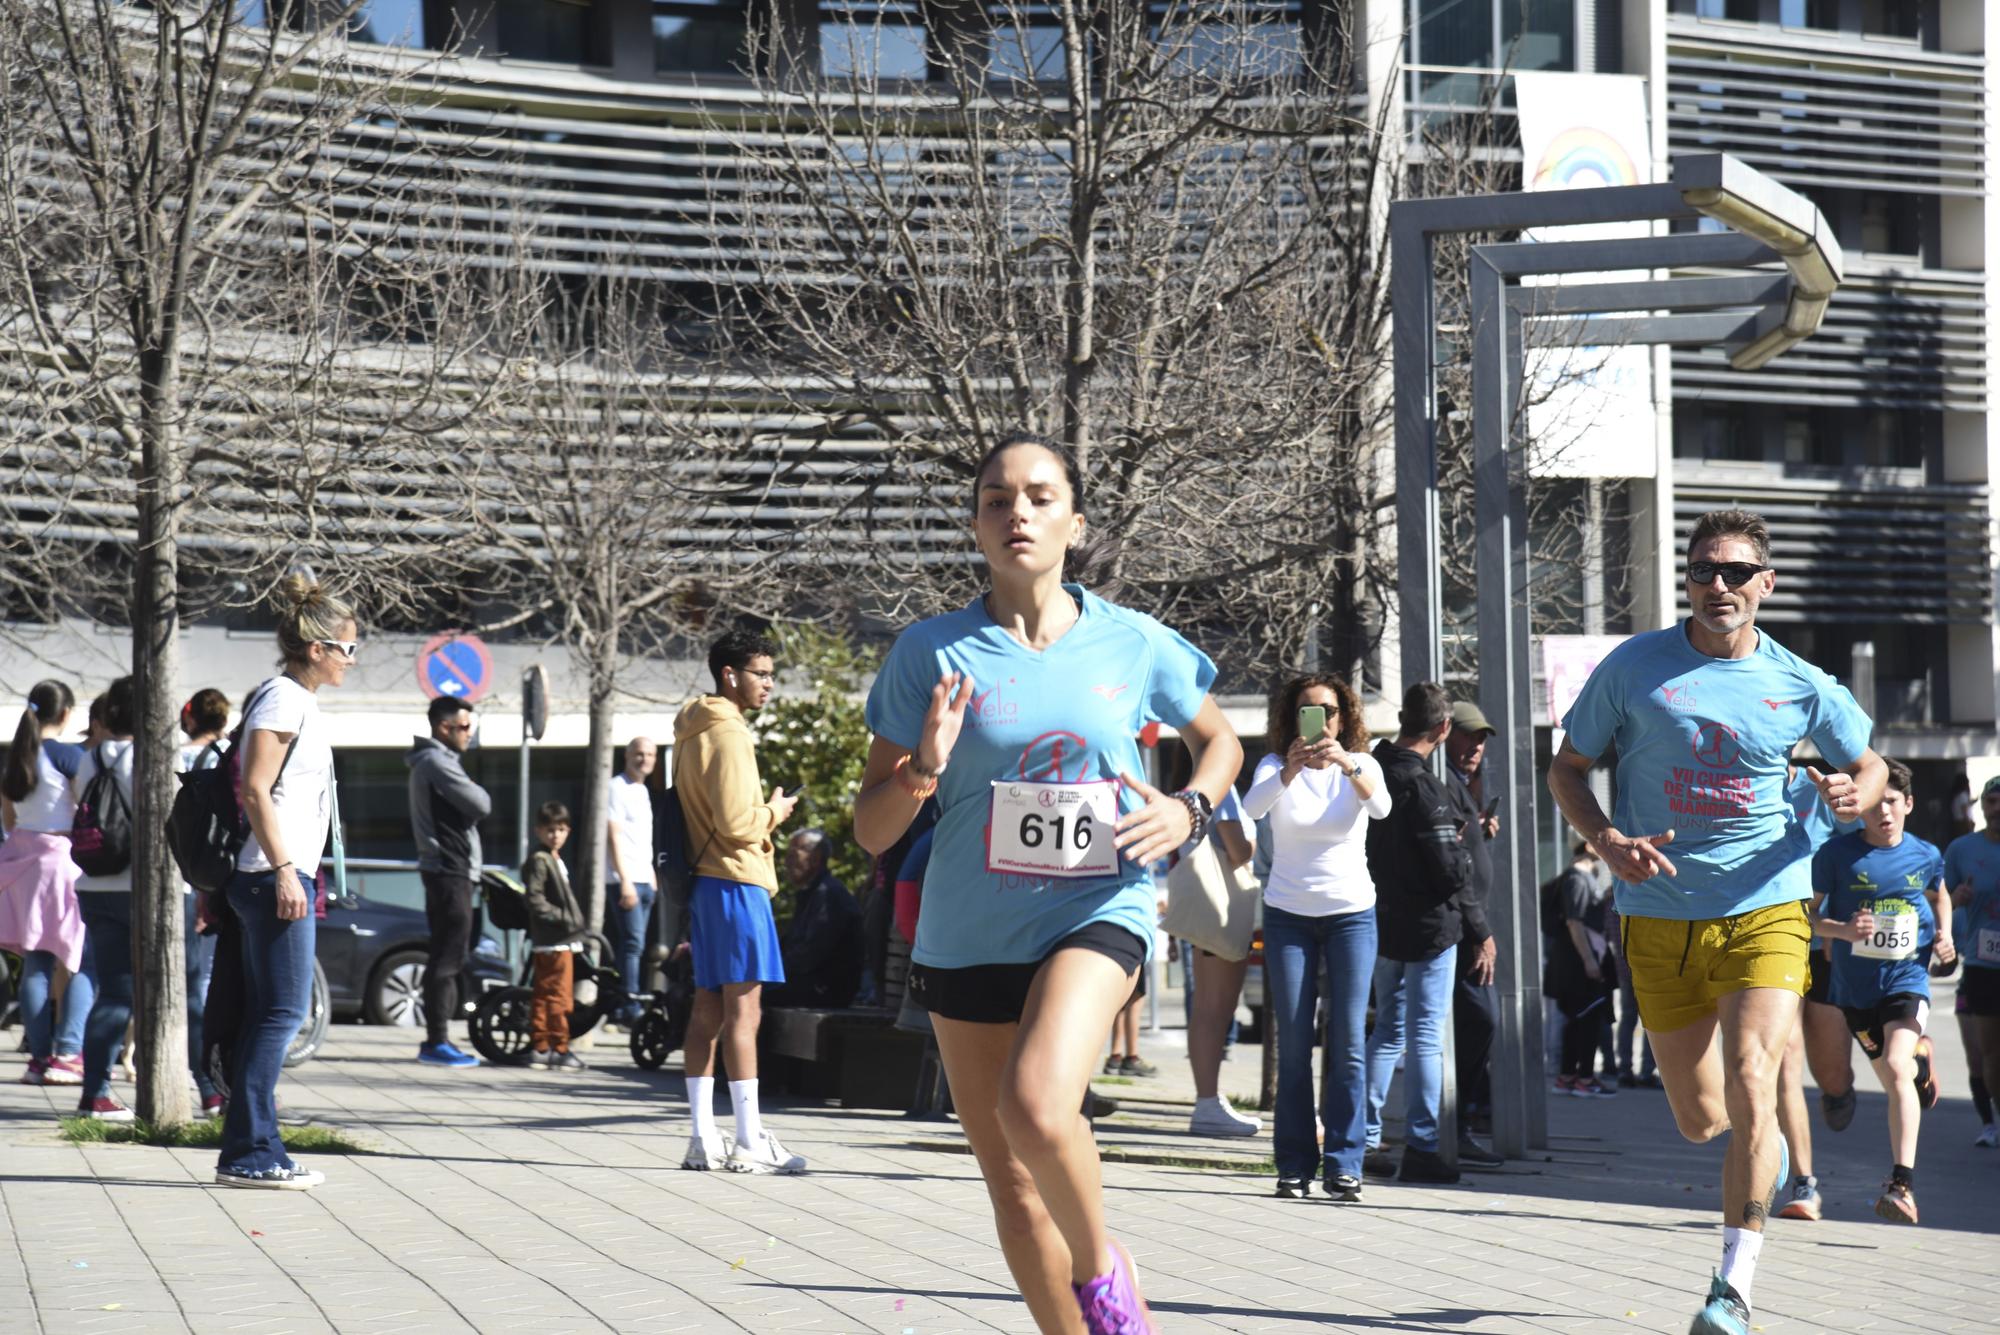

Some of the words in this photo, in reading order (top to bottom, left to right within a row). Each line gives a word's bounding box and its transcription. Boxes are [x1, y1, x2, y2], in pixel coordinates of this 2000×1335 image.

[1672, 767, 1694, 784] VII
[1696, 770, 1751, 790] CURSA
[1664, 779, 1684, 797] DE
[1686, 785, 1708, 801] LA
[1711, 788, 1756, 804] DONA
[1669, 797, 1749, 817] MANRESA
[1020, 812, 1092, 850] 616
